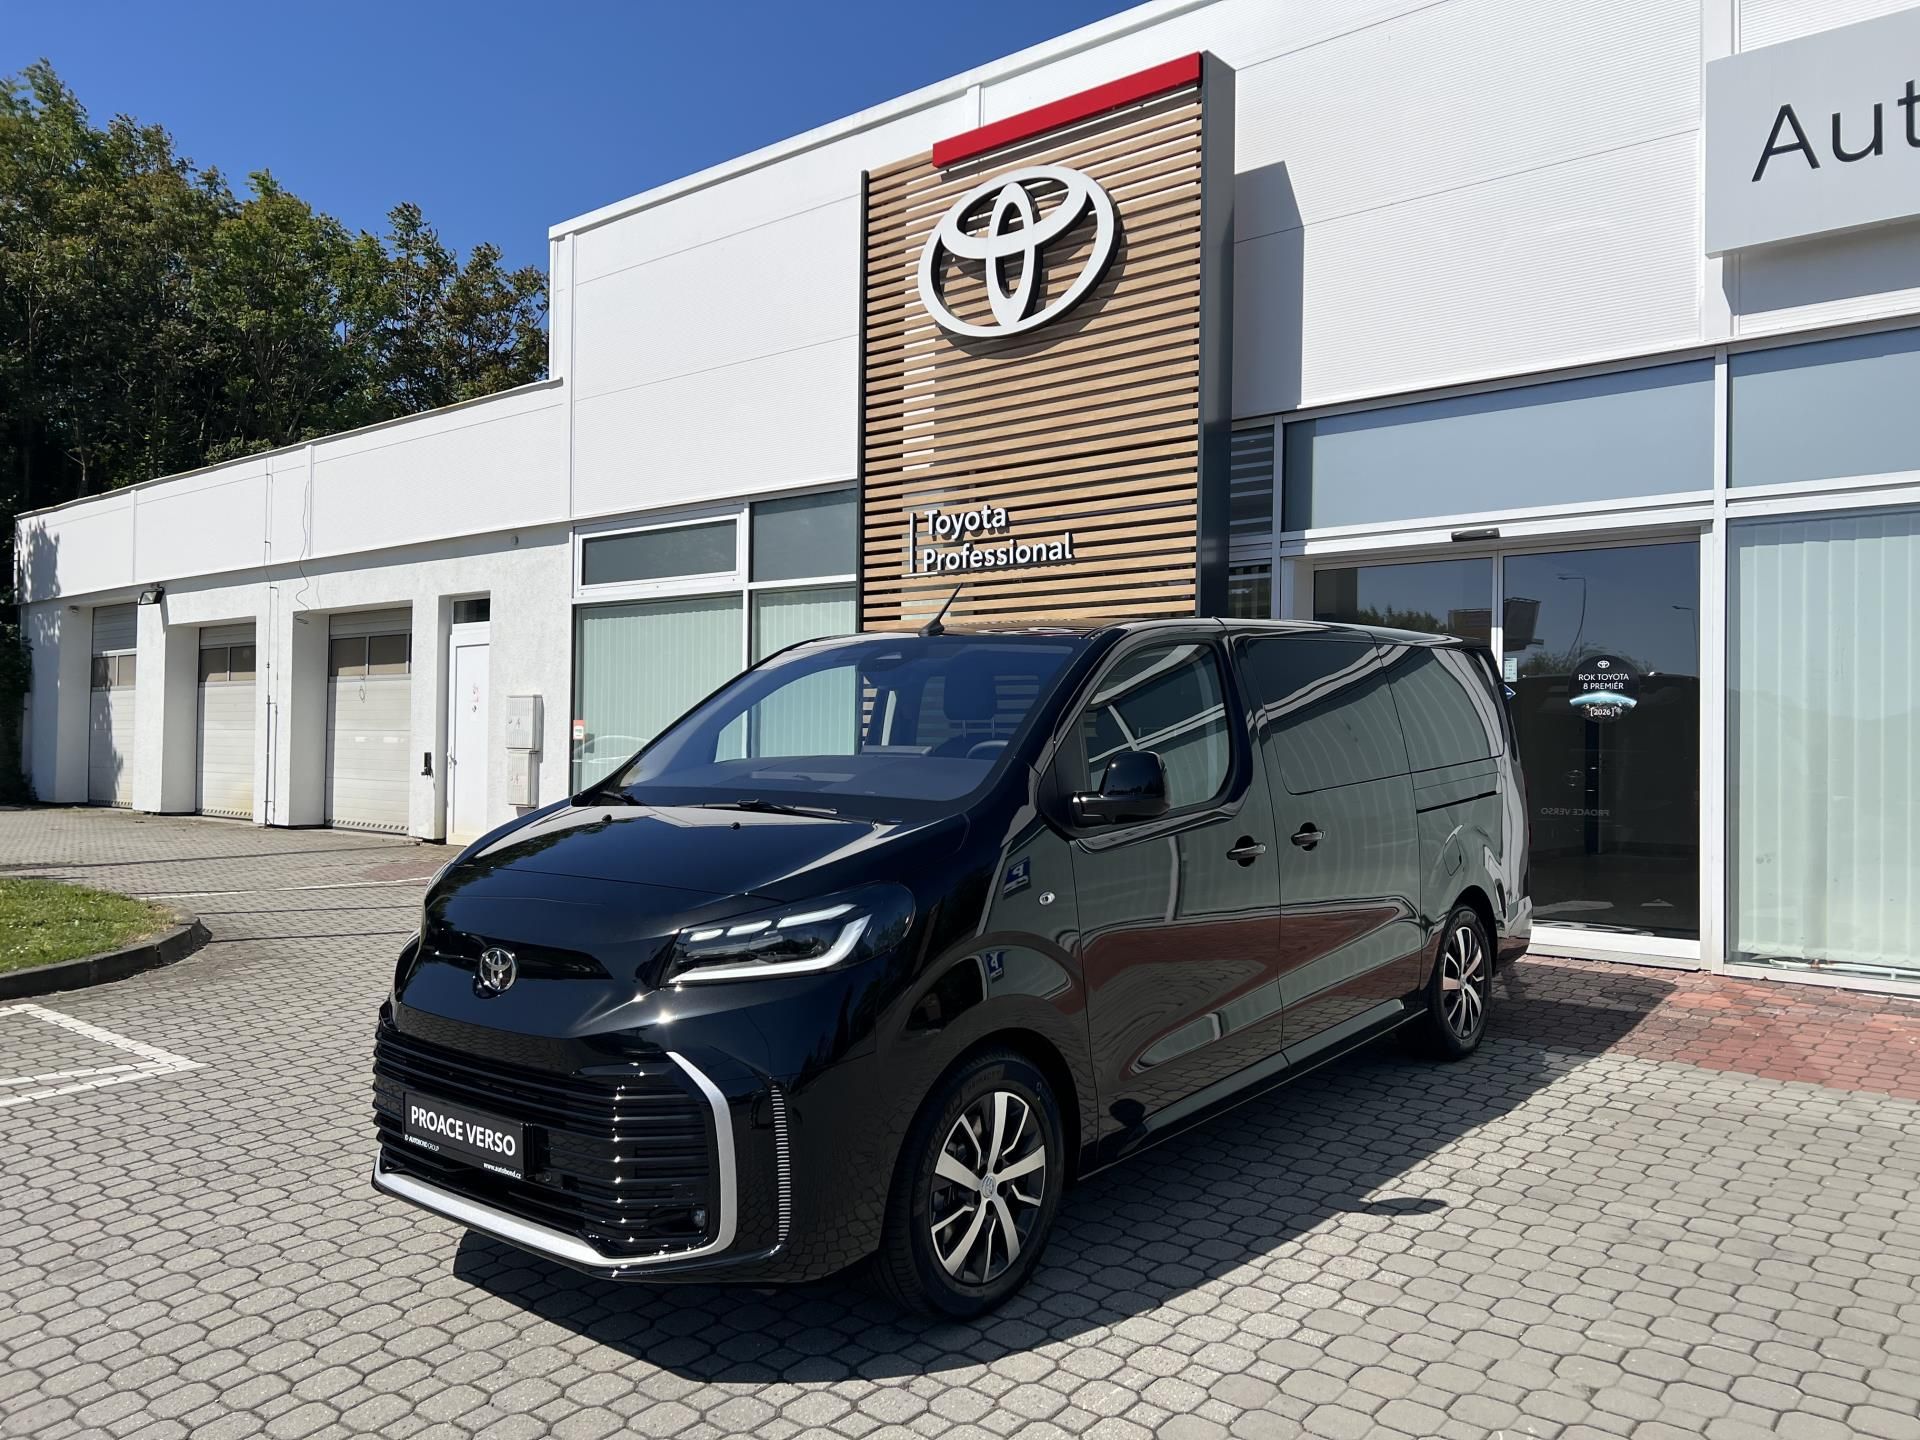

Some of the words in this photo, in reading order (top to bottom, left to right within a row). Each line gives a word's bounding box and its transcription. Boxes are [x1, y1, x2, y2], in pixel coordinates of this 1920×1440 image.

[924, 504, 1007, 540] Toyota
[923, 531, 1073, 572] Professional
[1578, 673, 1596, 681] ROK
[1597, 673, 1630, 681] TOYOTA
[1590, 681, 1624, 690] PREMIÉR
[411, 1105, 463, 1140] PROACE
[466, 1122, 516, 1157] VERSO
